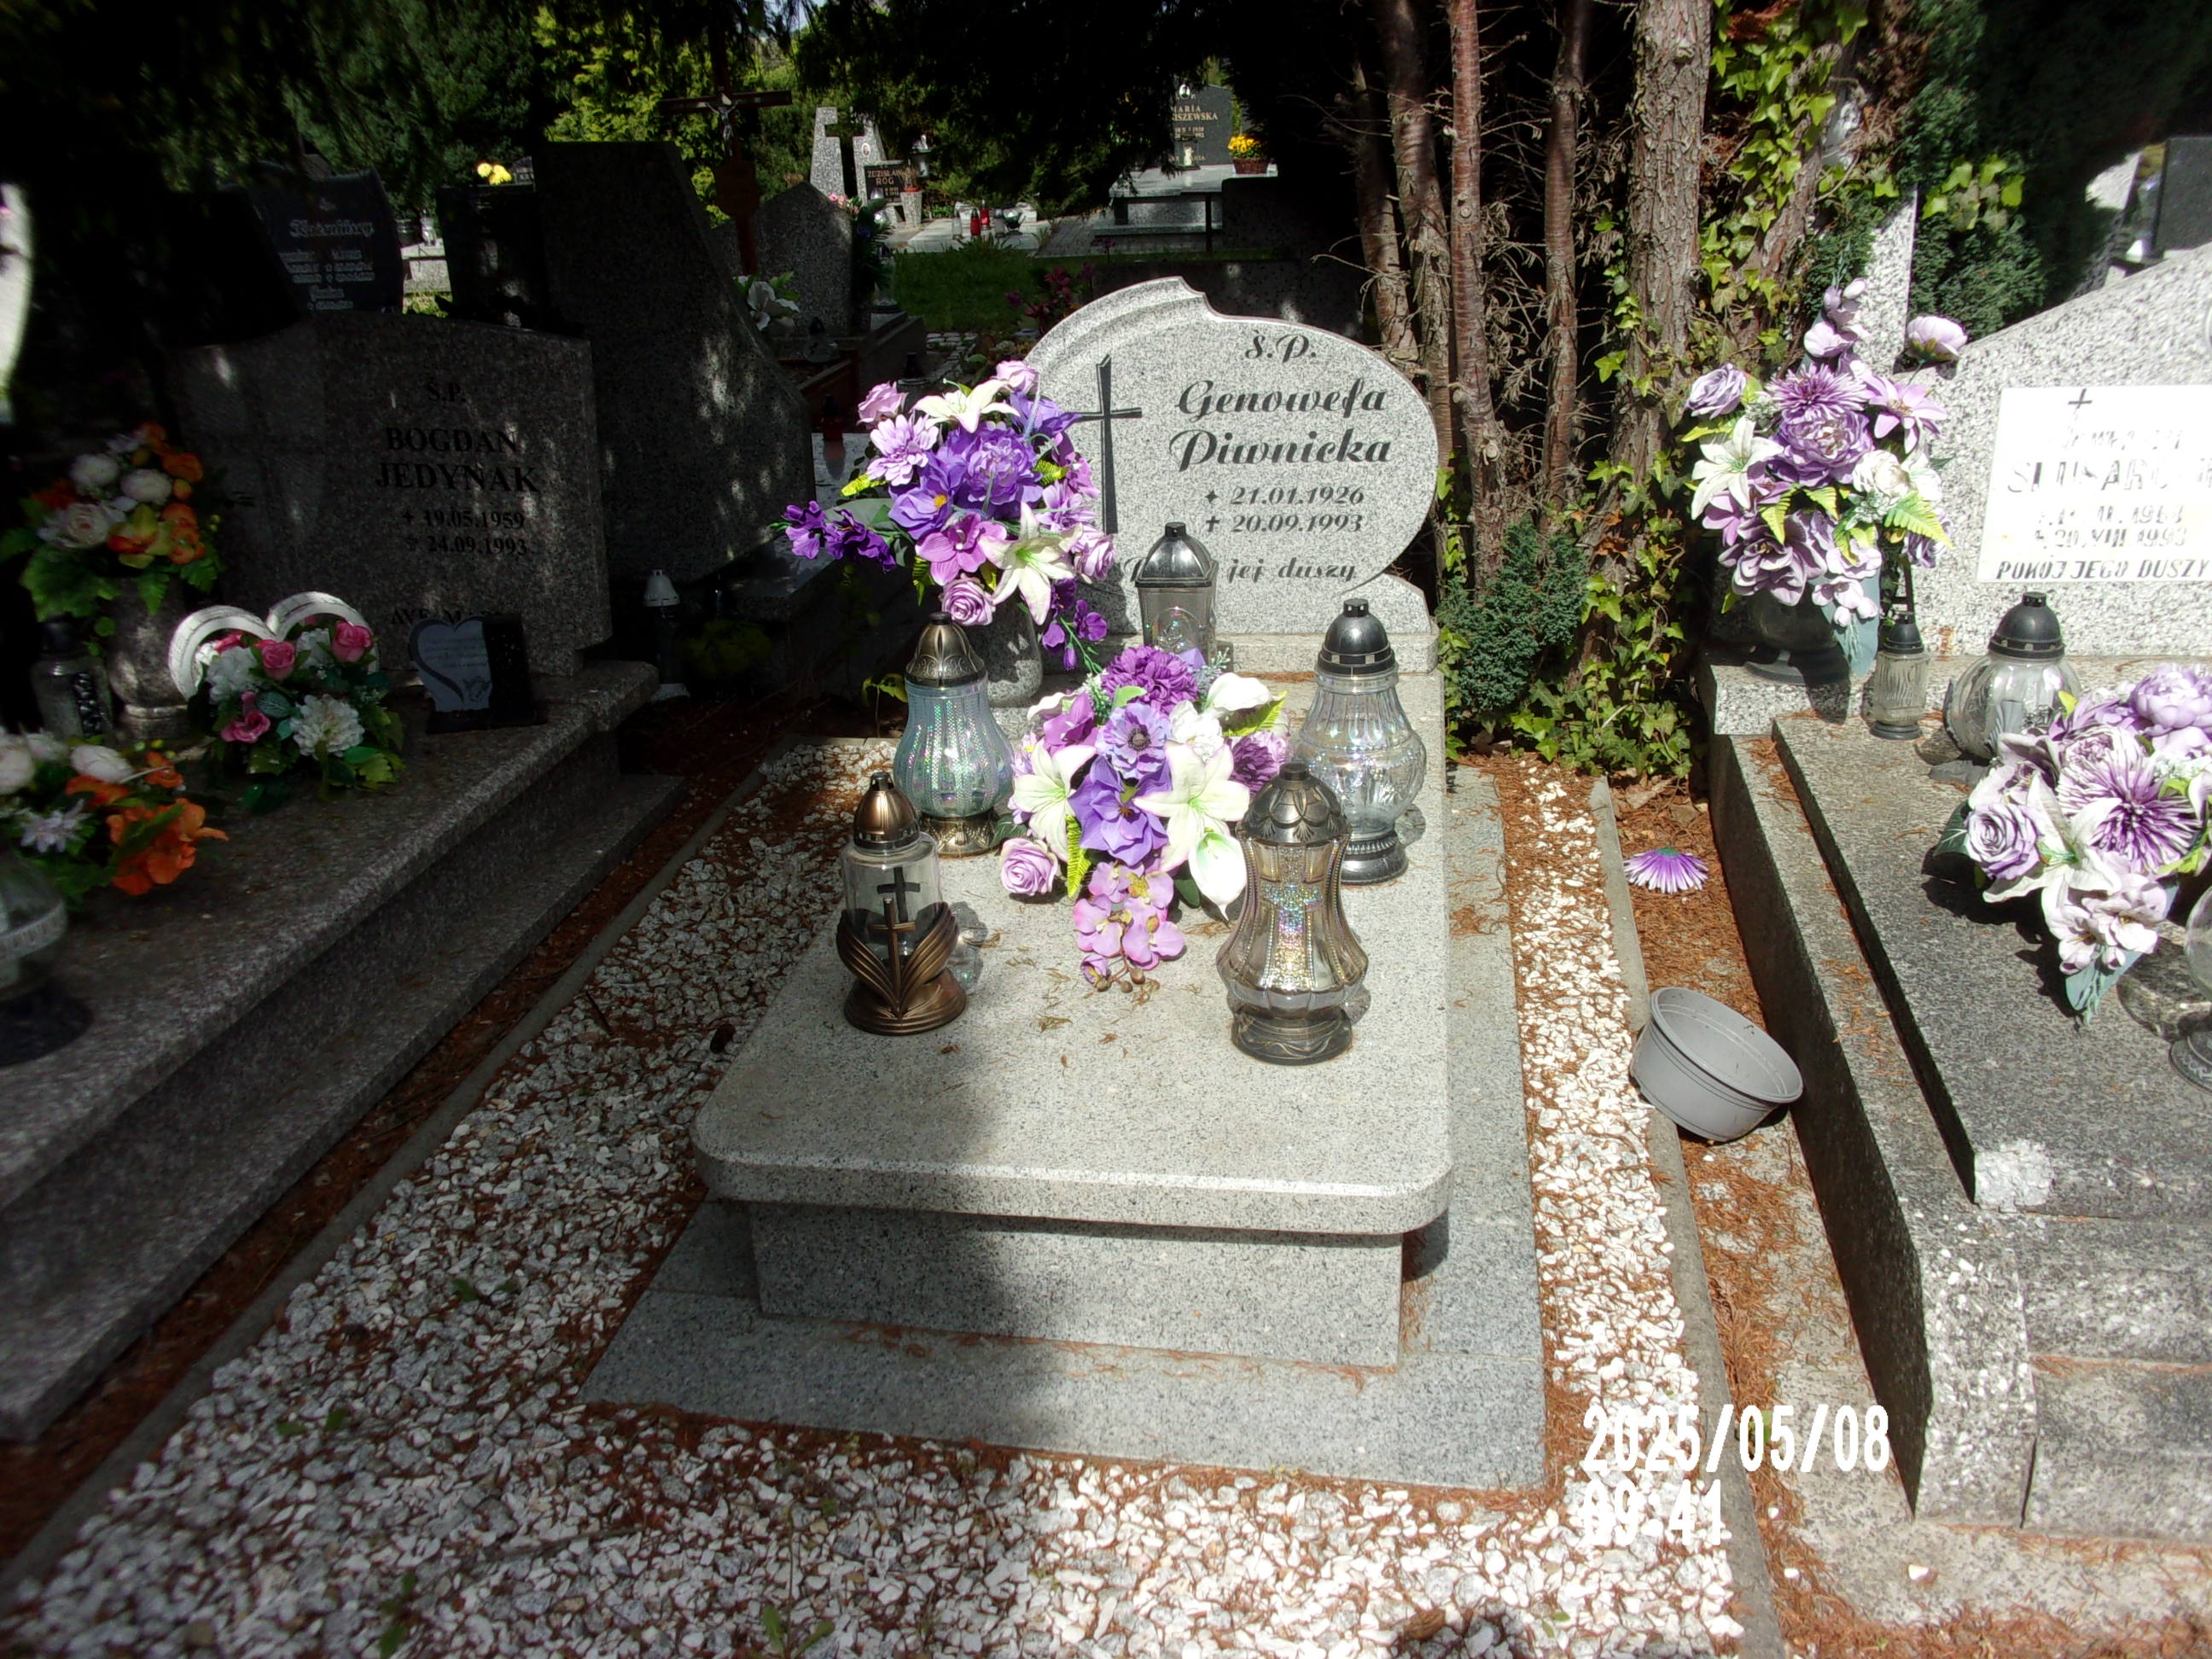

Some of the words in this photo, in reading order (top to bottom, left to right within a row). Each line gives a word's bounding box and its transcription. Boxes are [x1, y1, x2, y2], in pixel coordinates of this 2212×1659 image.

[1174, 379, 1388, 422] Genowefa
[387, 427, 518, 453] BOGDAN
[1169, 428, 1393, 472] Piwnicka
[375, 462, 539, 492] JEDYNAK
[1231, 486, 1365, 506] 21.01.1926
[424, 509, 525, 530] 19.05.1959
[1231, 514, 1363, 534] 20.09.1993
[428, 535, 527, 555] 24.09.1993
[1226, 559, 1264, 583] jej
[1278, 556, 1357, 583] duszy
[2069, 559, 2129, 579] JEGO
[2136, 559, 2210, 579] DUSZY
